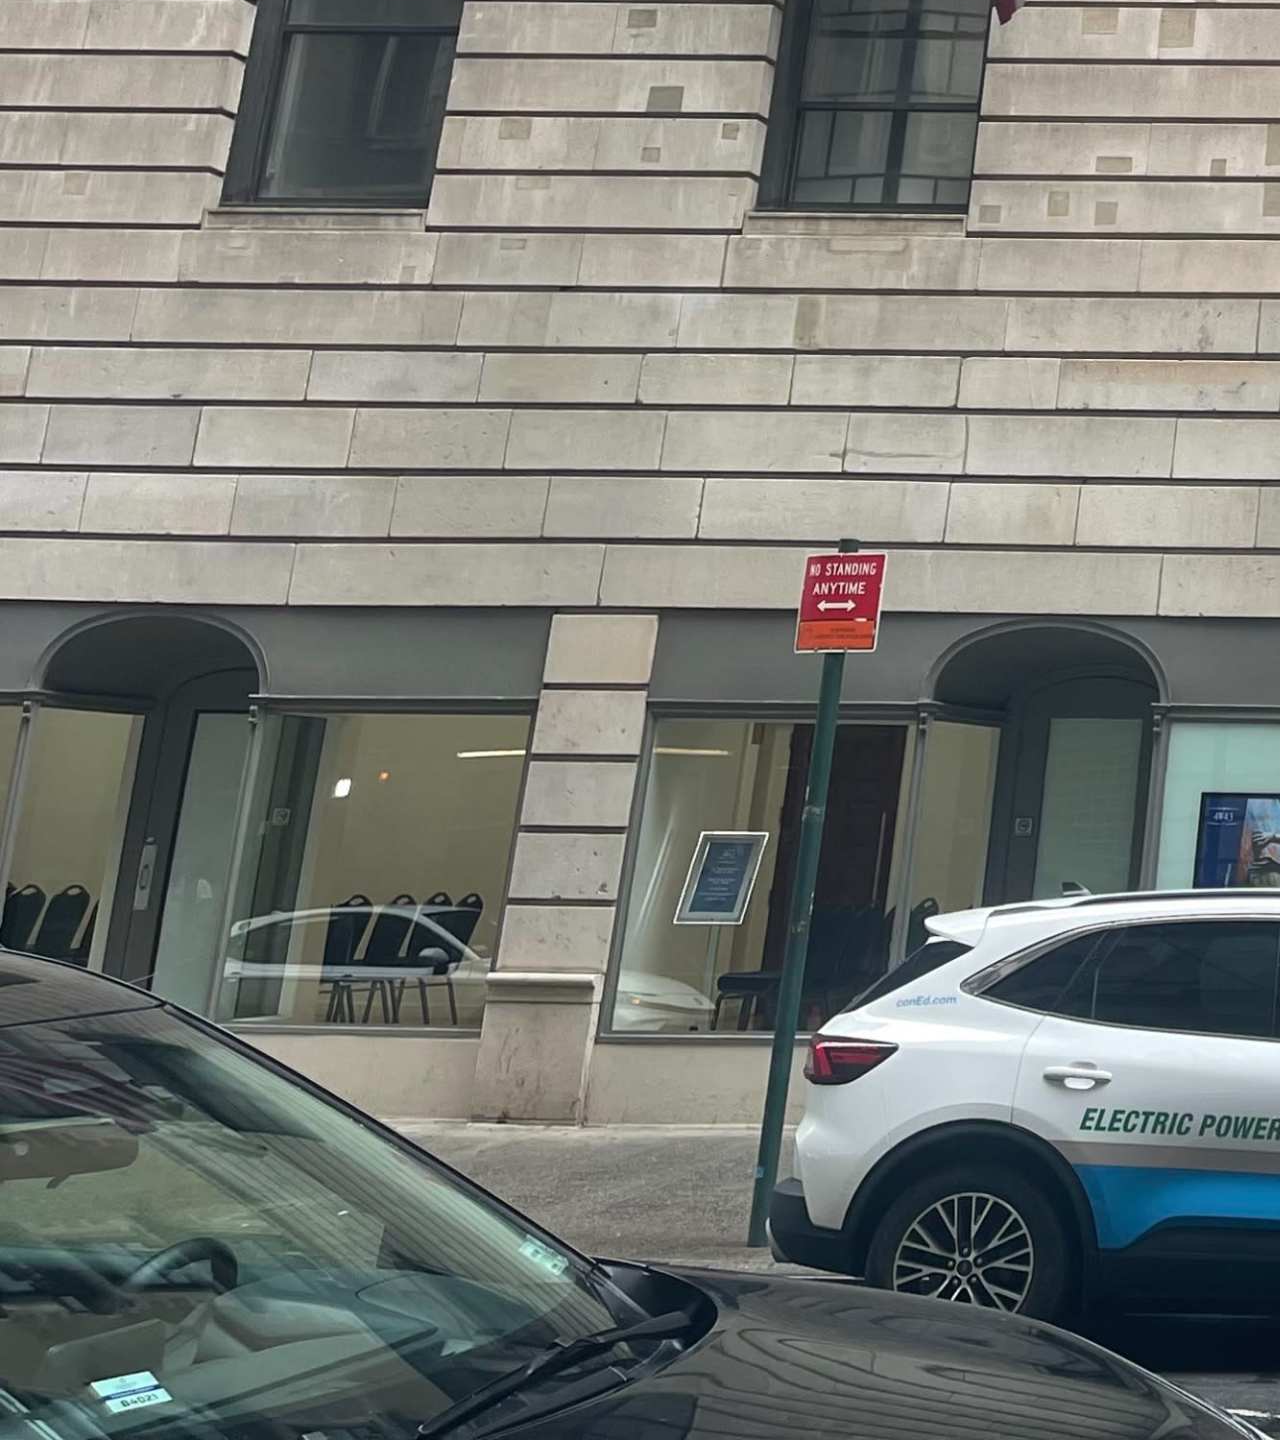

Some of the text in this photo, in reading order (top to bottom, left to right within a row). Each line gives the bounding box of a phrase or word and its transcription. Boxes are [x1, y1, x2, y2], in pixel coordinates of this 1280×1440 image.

[809, 563, 877, 576] NO STANDING
[812, 582, 866, 595] ANYTIME
[896, 995, 957, 1007] conEd.com
[1080, 1107, 1193, 1136] ELECTRIC
